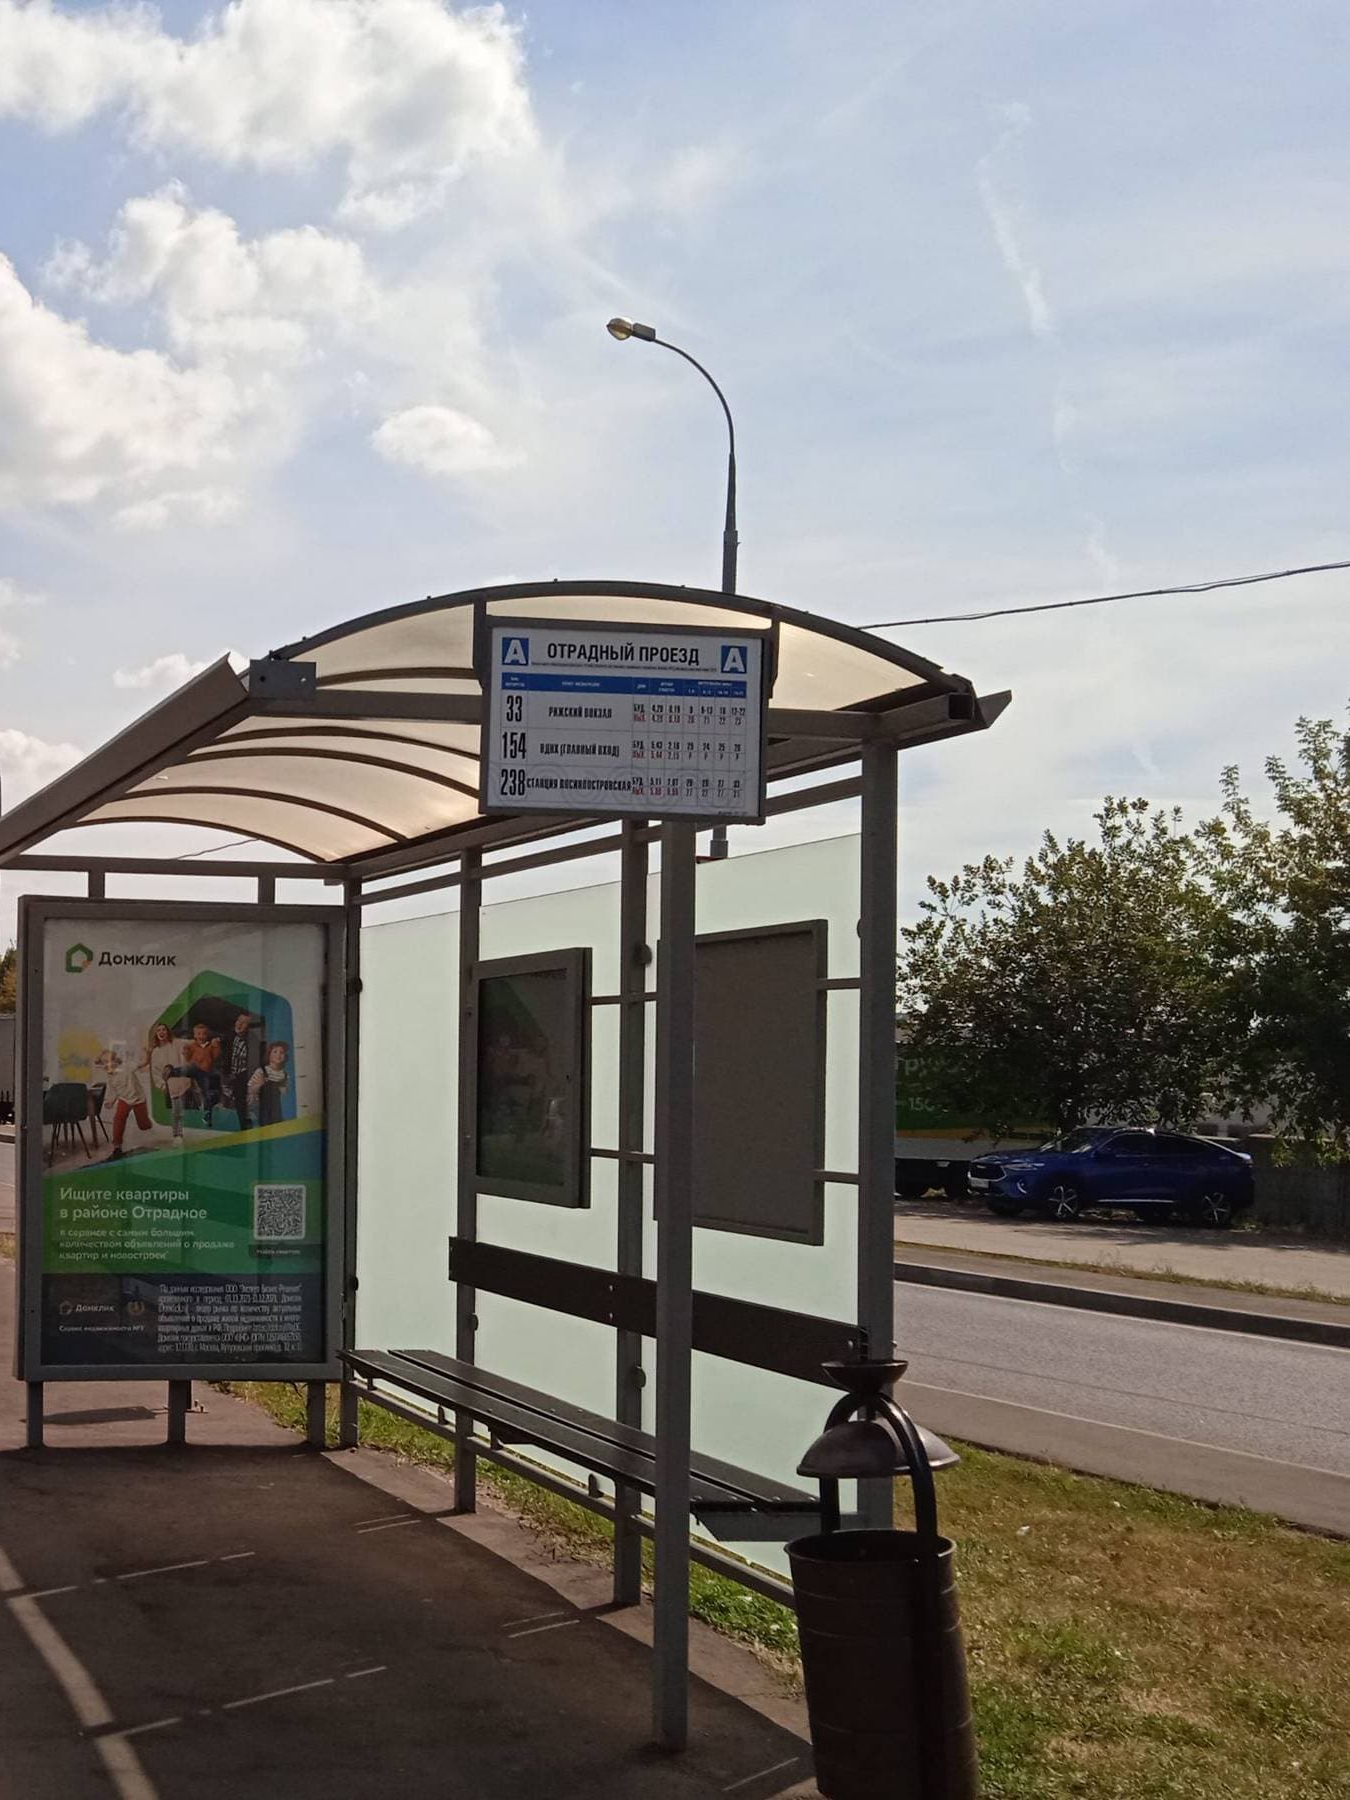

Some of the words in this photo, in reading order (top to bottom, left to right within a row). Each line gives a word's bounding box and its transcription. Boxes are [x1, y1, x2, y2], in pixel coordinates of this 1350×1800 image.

[547, 641, 634, 662] ОТРАДНЫЙ
[639, 646, 700, 666] ПРОЕЗД
[506, 695, 523, 722] 33
[548, 706, 583, 718] РИЖСКИЙ
[584, 708, 612, 719] ВОКЗАЛ
[502, 732, 526, 759] 154
[501, 769, 526, 796] 238
[527, 778, 559, 790] СТАНЦИЯ
[98, 951, 177, 967] Домклик
[60, 1187, 111, 1202] Ищите
[116, 1188, 189, 1203] квартиры
[59, 1209, 68, 1219] в
[73, 1205, 128, 1221] районе
[132, 1206, 208, 1220] Отрадное
